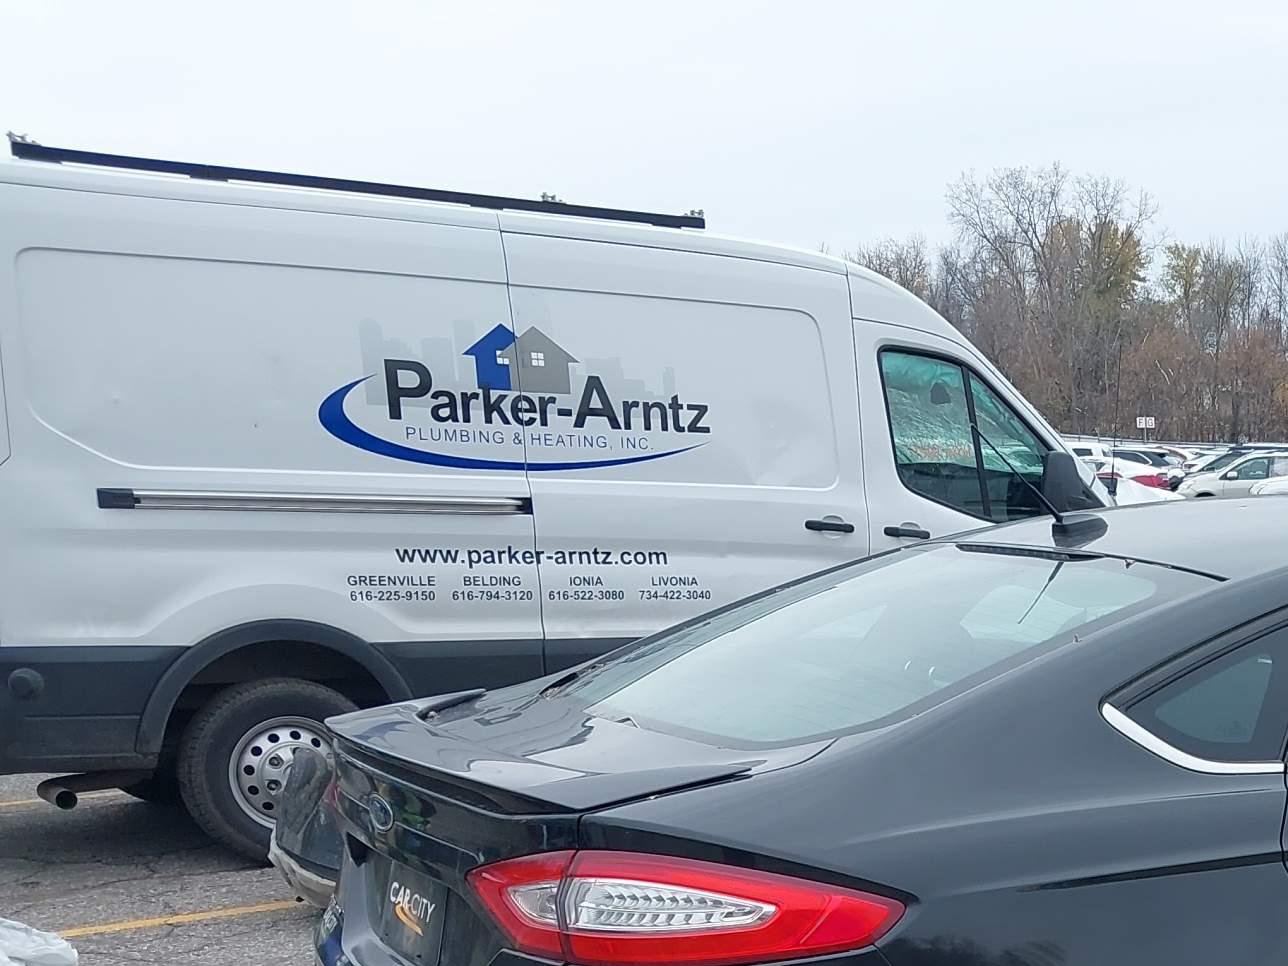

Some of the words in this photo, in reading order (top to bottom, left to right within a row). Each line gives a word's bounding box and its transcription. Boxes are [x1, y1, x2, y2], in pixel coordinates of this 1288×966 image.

[383, 358, 712, 434] Parker-Arntz
[405, 426, 505, 445] PLUMBING
[512, 432, 524, 445] &
[530, 433, 613, 451] HEATING,
[620, 436, 654, 450] INC.
[395, 545, 669, 569] www.parker-arntz.com
[347, 575, 436, 587] GREENVILLE
[462, 575, 522, 587] BELDING
[569, 576, 604, 587] IONIA
[651, 576, 699, 587] LIVONIA
[349, 590, 436, 602] 616-225-9150
[451, 590, 534, 601] 616-794-3120
[547, 590, 625, 601] 616-522-3080
[638, 590, 711, 601] 734-422-3040
